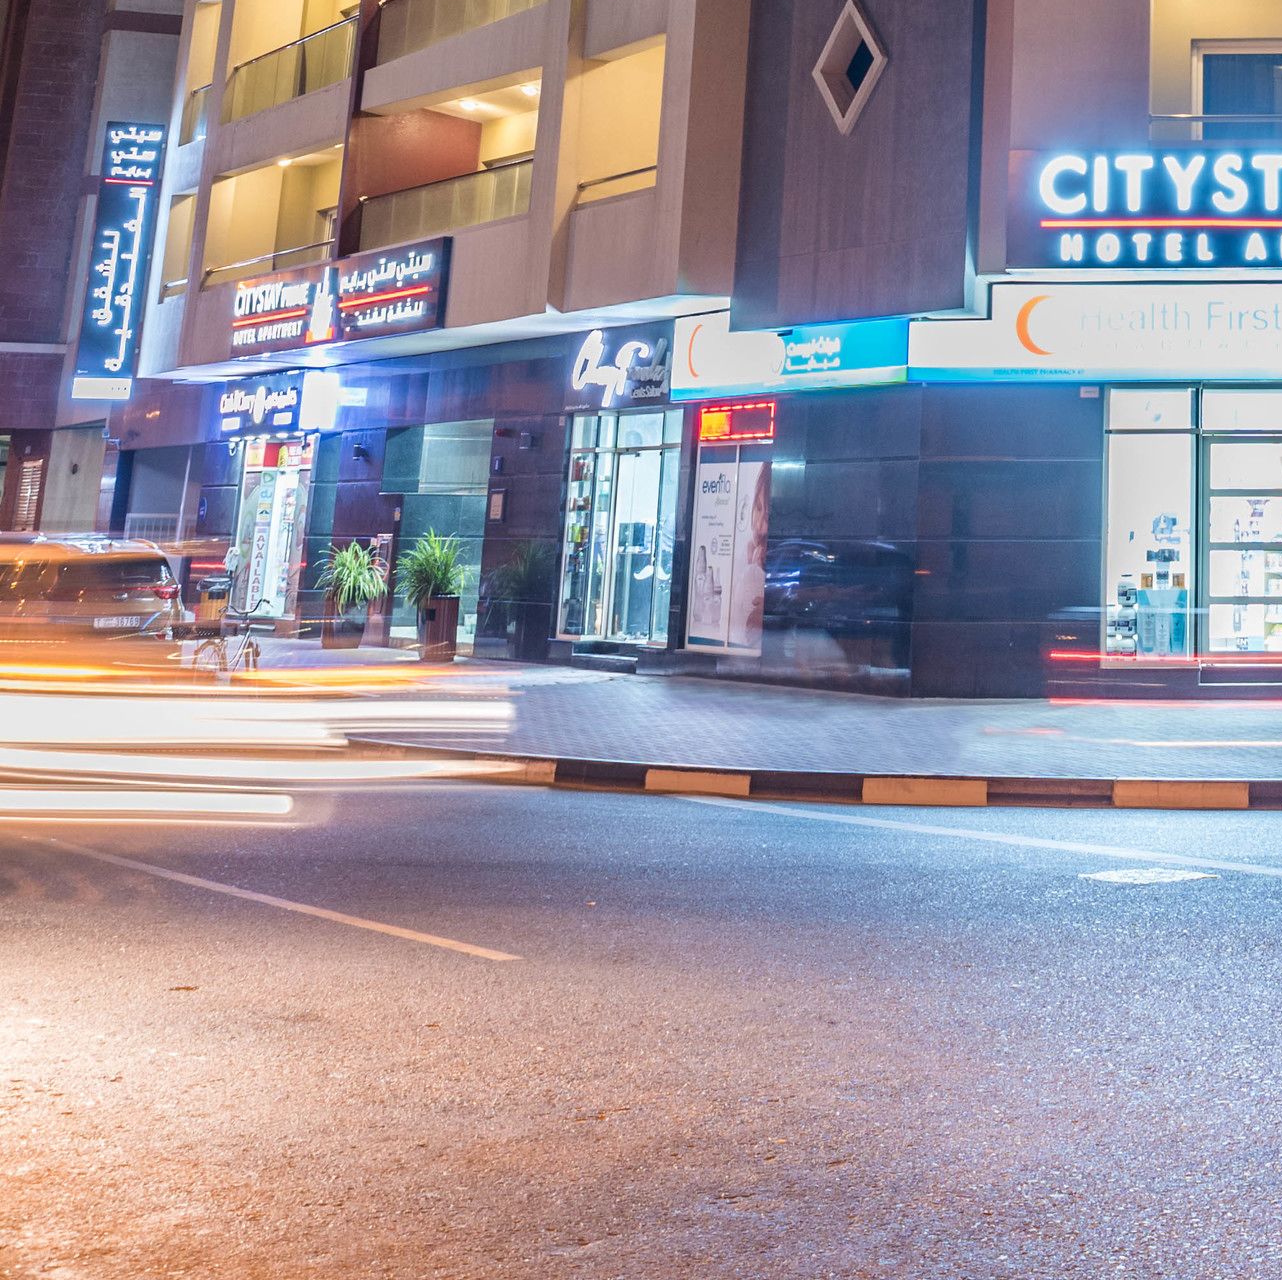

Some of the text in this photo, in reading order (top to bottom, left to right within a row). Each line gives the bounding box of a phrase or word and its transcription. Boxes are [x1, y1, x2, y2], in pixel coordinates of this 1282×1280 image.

[110, 126, 163, 144] سيتي
[110, 146, 157, 164] ستي
[1059, 232, 1215, 263] HOTEL
[1080, 300, 1282, 331] Health First
